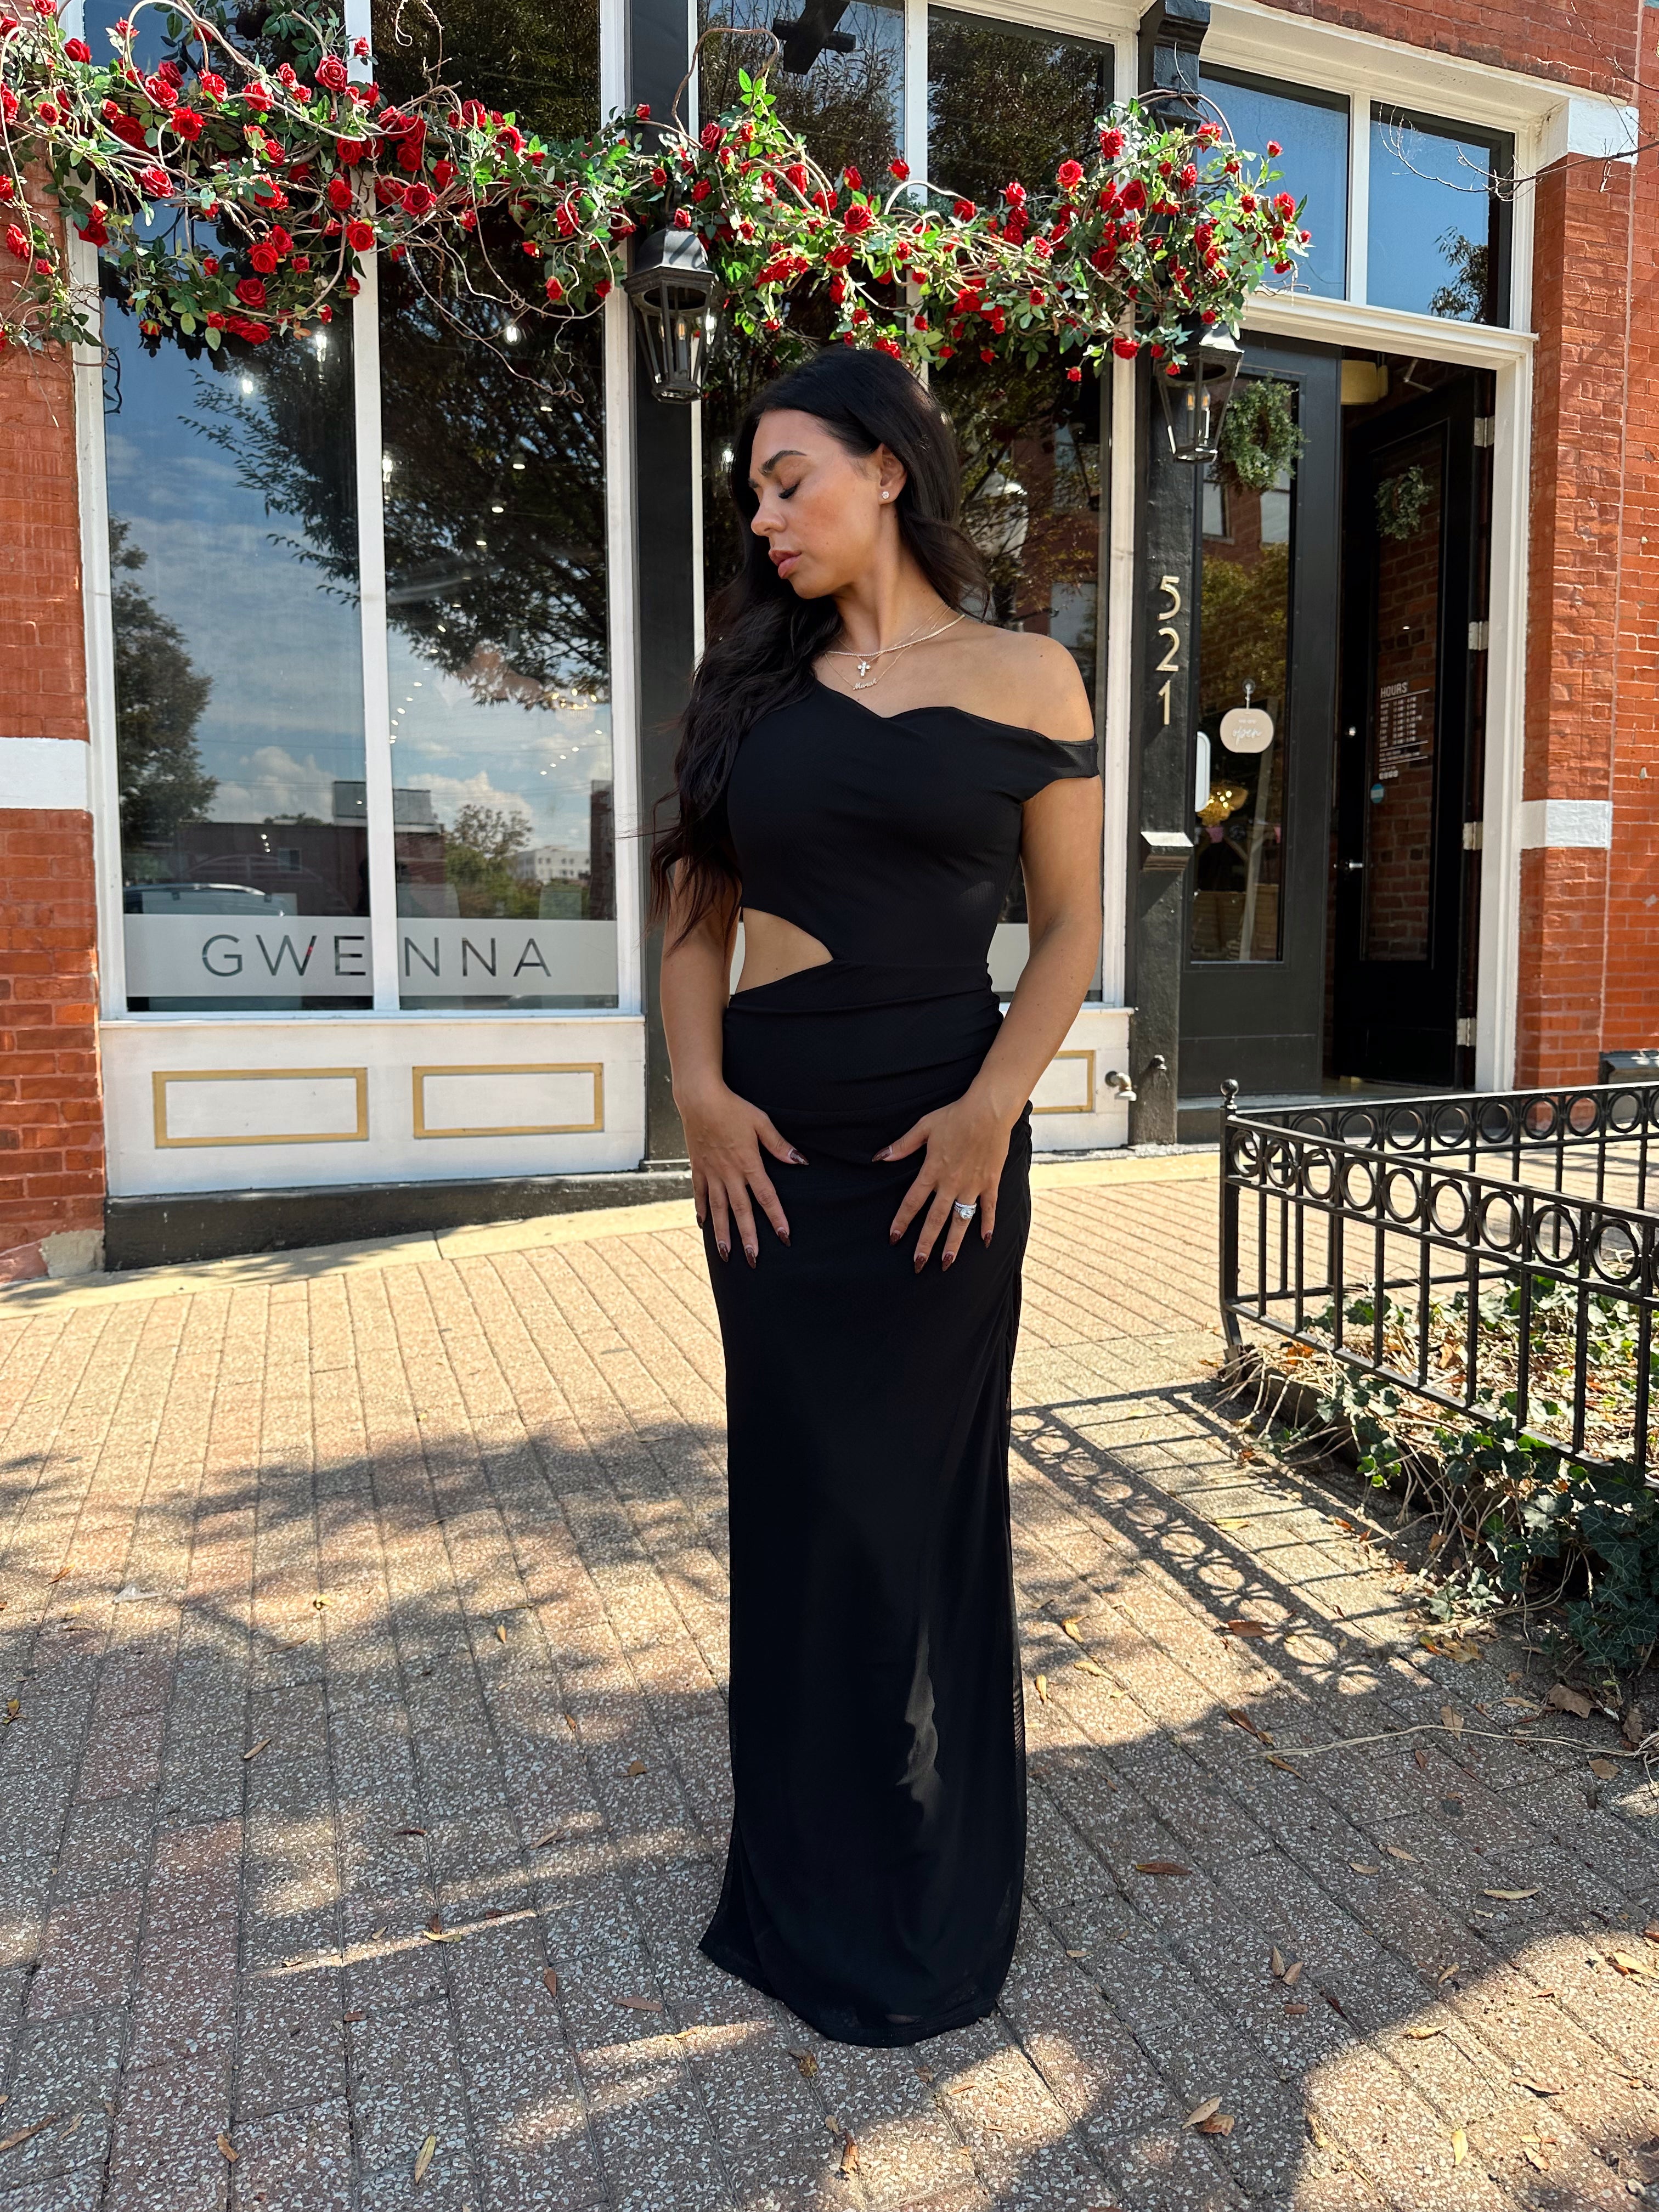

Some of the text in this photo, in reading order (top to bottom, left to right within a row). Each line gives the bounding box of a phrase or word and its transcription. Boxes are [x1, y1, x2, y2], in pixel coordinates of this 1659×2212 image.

[1155, 575, 1181, 725] 521
[1380, 681, 1408, 698] HOURS
[1232, 726, 1262, 746] open
[202, 934, 552, 977] GWENNA
